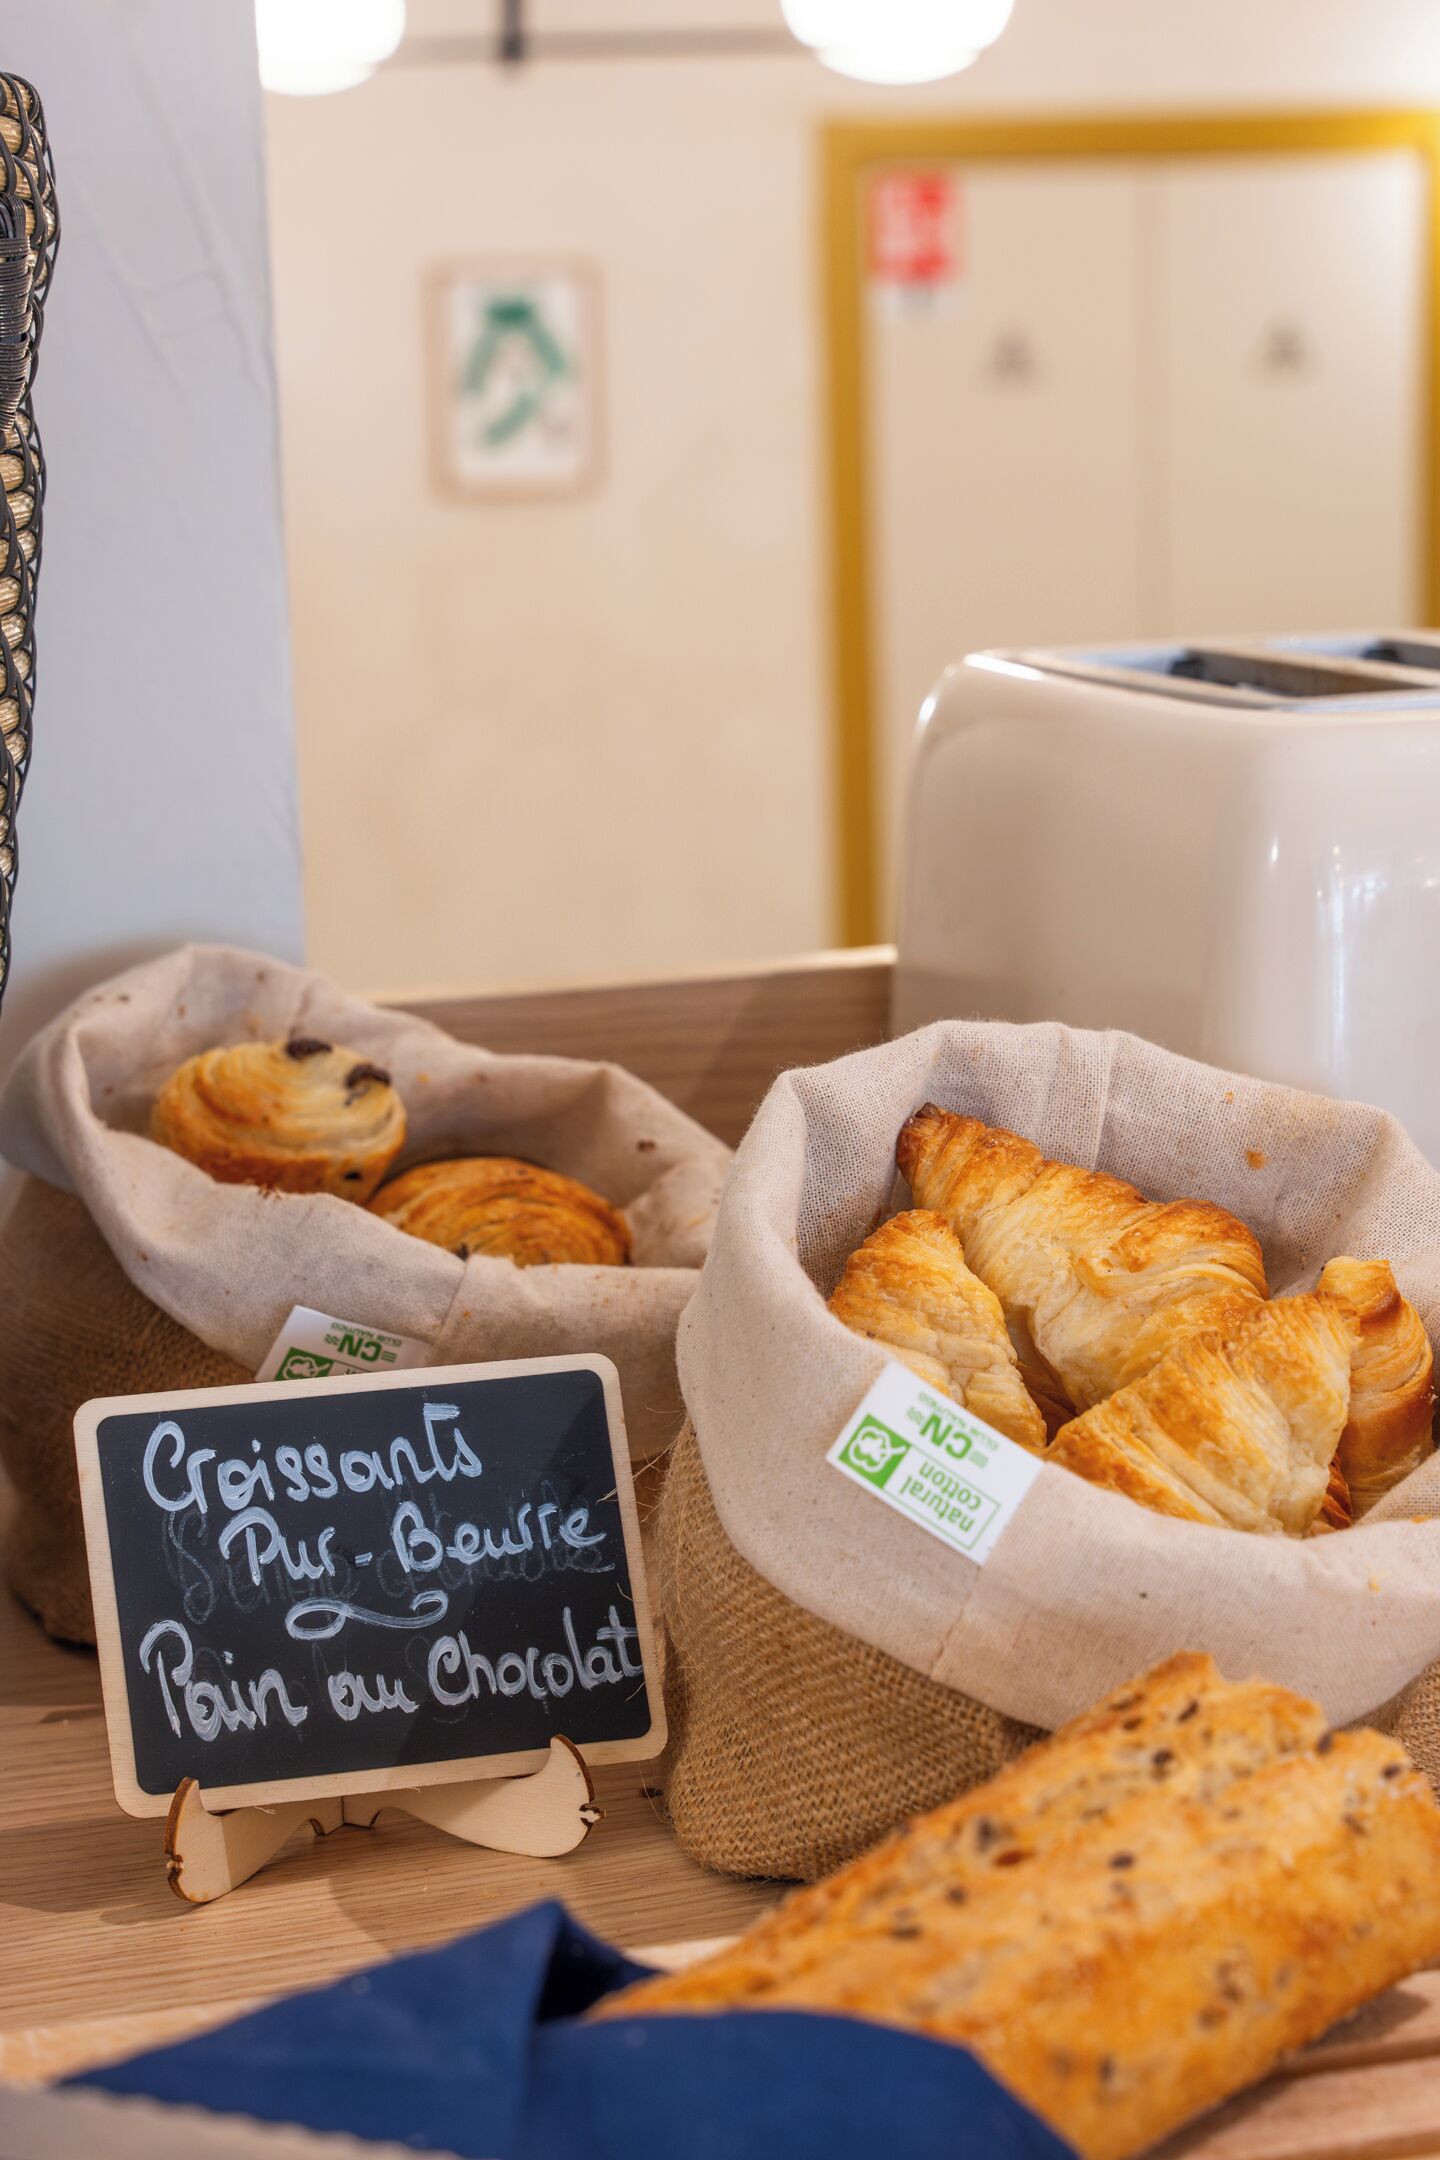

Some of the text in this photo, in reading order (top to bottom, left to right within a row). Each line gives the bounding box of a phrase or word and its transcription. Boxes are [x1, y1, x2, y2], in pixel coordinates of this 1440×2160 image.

[337, 1333, 383, 1363] CN
[142, 1401, 484, 1514] Croissants
[919, 1413, 973, 1460] CN
[899, 1475, 975, 1532] natural
[919, 1461, 982, 1511] cotton
[138, 1604, 644, 1742] Pain au Chocolat
